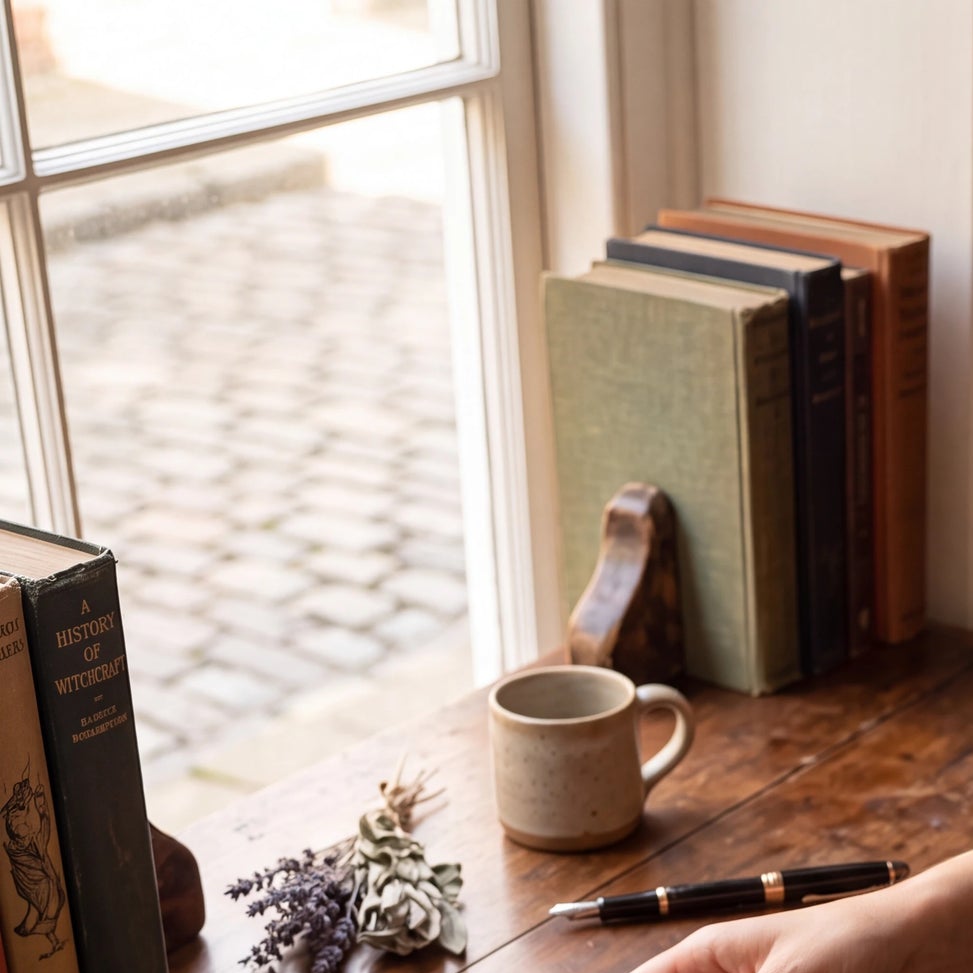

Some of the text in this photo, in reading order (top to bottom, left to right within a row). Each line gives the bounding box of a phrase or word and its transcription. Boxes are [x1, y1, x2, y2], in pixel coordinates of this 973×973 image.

[81, 600, 91, 616] A
[55, 611, 116, 649] HISTORY
[84, 643, 100, 662] OF
[55, 654, 126, 696] WITCHCRAFT
